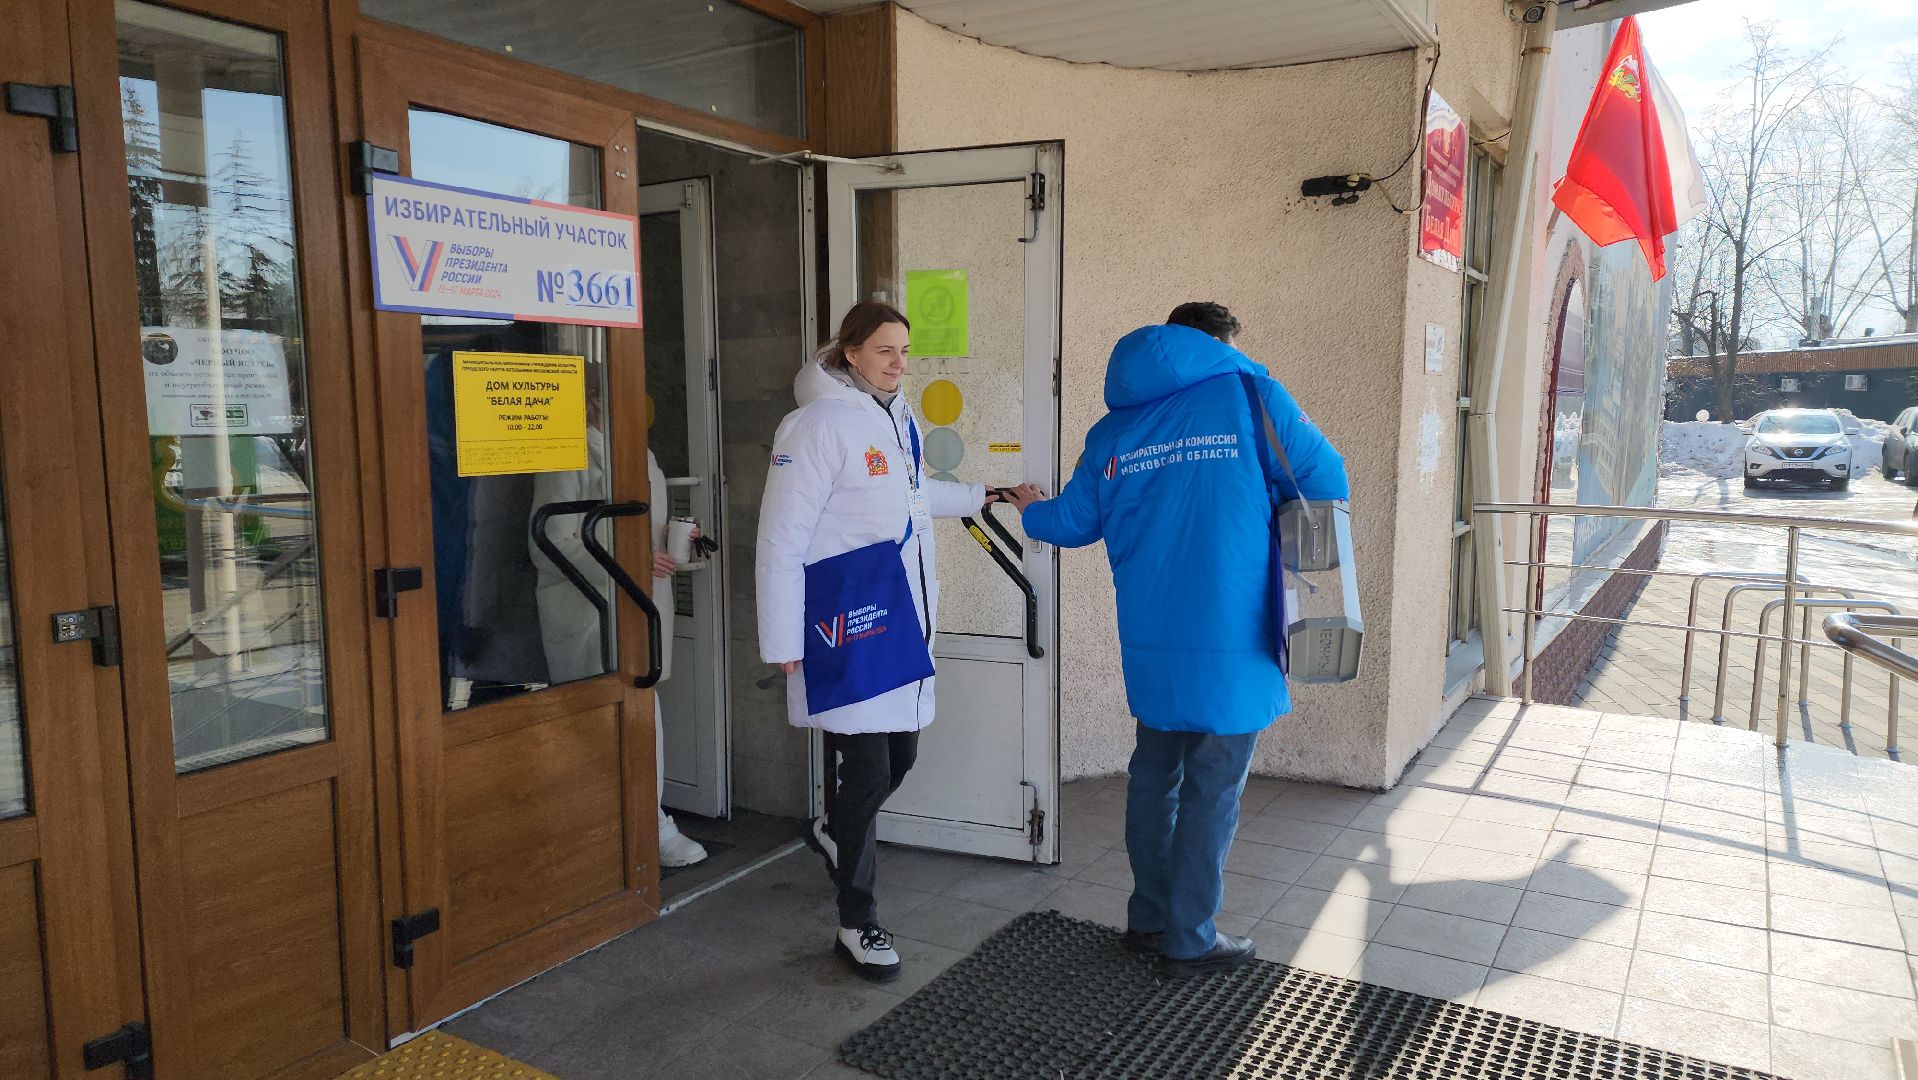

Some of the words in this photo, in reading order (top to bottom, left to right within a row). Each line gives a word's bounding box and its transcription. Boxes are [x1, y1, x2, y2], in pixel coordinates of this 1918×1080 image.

[384, 196, 550, 240] ИЗБИРАТЕЛЬНЫЙ
[556, 222, 627, 250] УЧАСТОК
[450, 243, 494, 258] ВЫБОРЫ
[445, 258, 508, 273] ПРЕЗИДЕНТА
[441, 272, 482, 285] РОССИИ
[486, 381, 510, 392] ДОМ
[512, 381, 560, 392] КУЛЬТУРЫ
[1186, 434, 1238, 448] КОМИССИЯ
[1187, 448, 1239, 461] ОБЛАСТИ
[847, 608, 888, 627] ПРЕЗИДЕНТА
[848, 604, 877, 619] ВЫБОРЫ
[846, 622, 873, 636] РОССИИ
